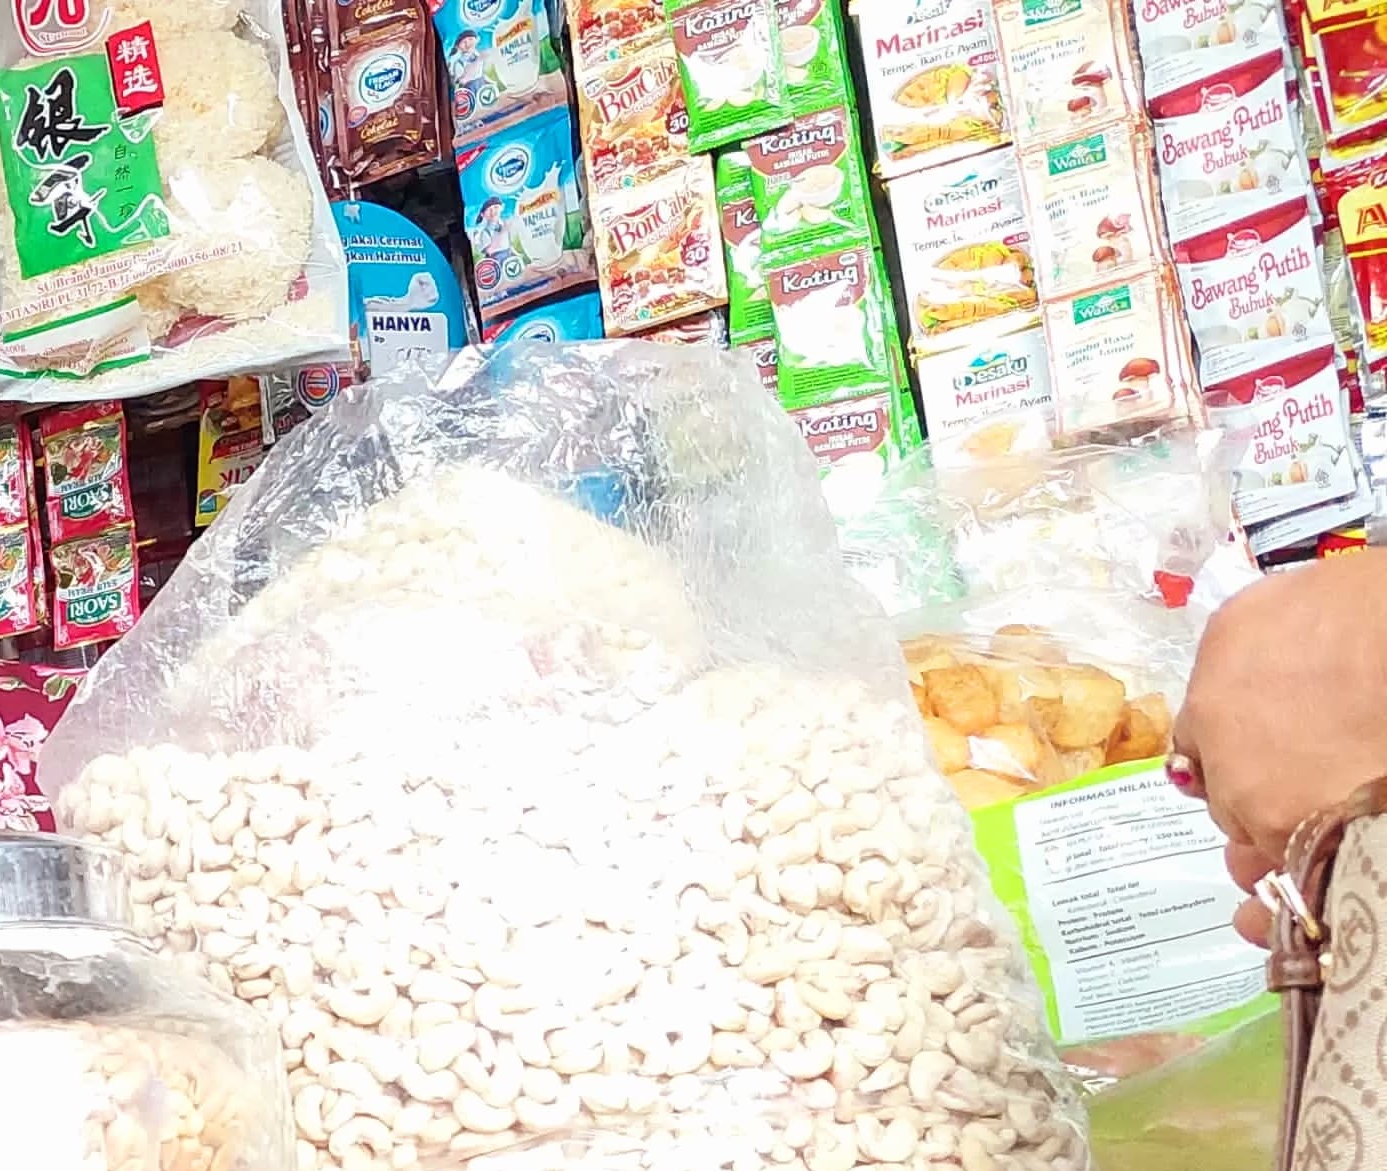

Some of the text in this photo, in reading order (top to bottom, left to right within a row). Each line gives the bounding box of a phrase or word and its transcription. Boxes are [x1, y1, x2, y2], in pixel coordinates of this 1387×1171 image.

[1183, 4, 1227, 29] Bubuk
[499, 34, 532, 56] VANILLA
[116, 35, 158, 97] 精选
[669, 114, 689, 129] 30
[1162, 98, 1284, 165] Bawang Putih
[759, 125, 835, 155] Kating
[14, 66, 112, 245] 银耳
[1202, 147, 1250, 174] Bubuk
[522, 205, 557, 227] VANILLA
[926, 197, 1004, 231] Marinasi
[350, 233, 422, 248] Akal Cermat
[684, 249, 706, 265] 30
[782, 266, 859, 293] Kating
[1191, 246, 1311, 310] Bawang Putih
[1228, 291, 1276, 320] Bubuk
[371, 315, 432, 332] HANYA
[955, 377, 1032, 408] Marinasi
[798, 411, 879, 438] Kating
[1282, 396, 1335, 426] Putih
[1254, 437, 1299, 464] Bubuk
[69, 592, 120, 618] SAORI
[1050, 780, 1152, 809] INFORMASI NILAI
